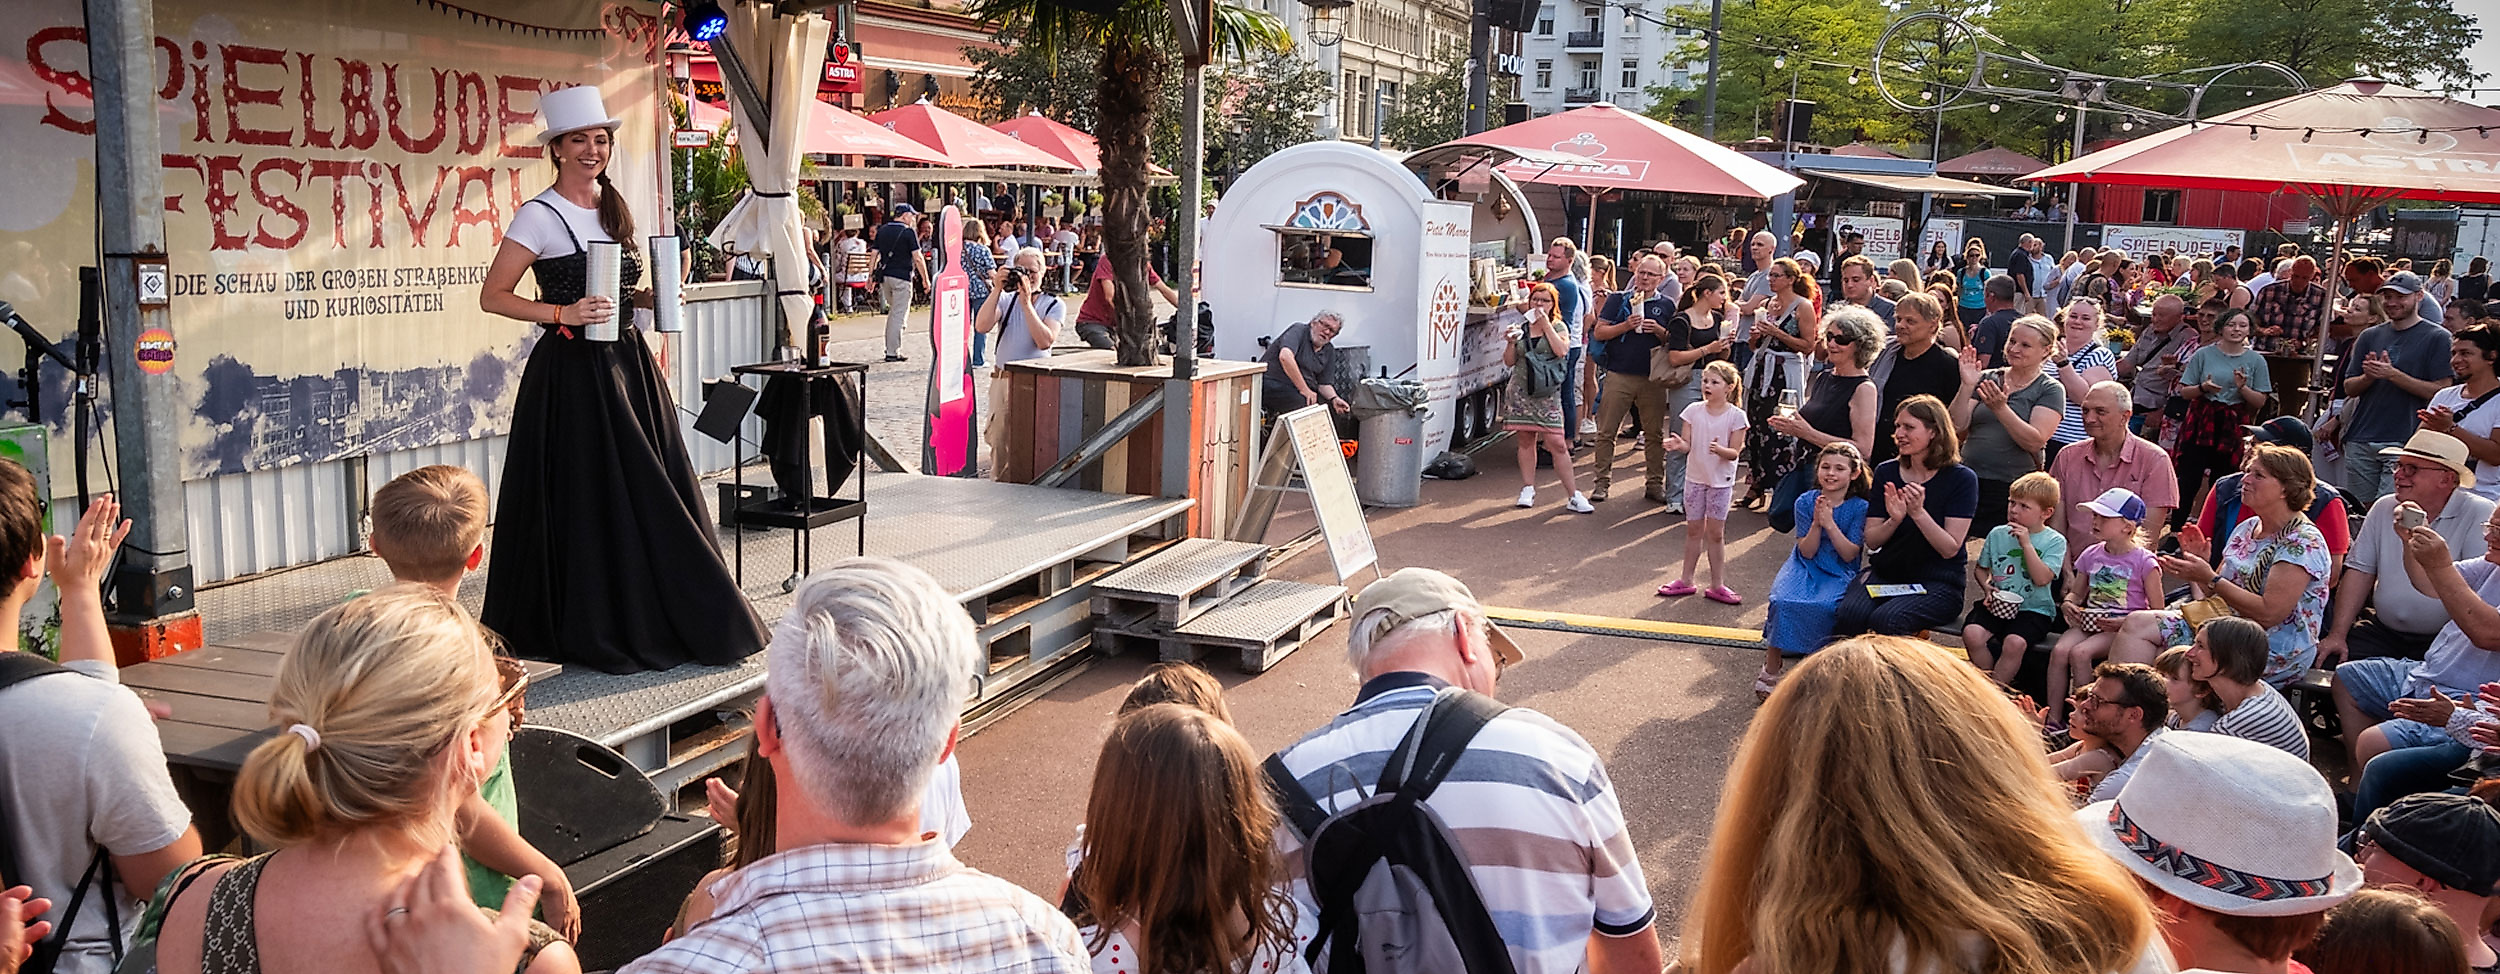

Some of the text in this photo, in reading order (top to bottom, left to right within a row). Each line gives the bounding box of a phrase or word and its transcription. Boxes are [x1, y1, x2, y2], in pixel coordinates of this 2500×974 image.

[829, 66, 856, 79] ASTRA
[174, 273, 207, 296] DIE
[213, 272, 277, 295] SCHAU
[284, 269, 317, 292] DER
[284, 290, 444, 321] UND KURIOSITÄTEN
